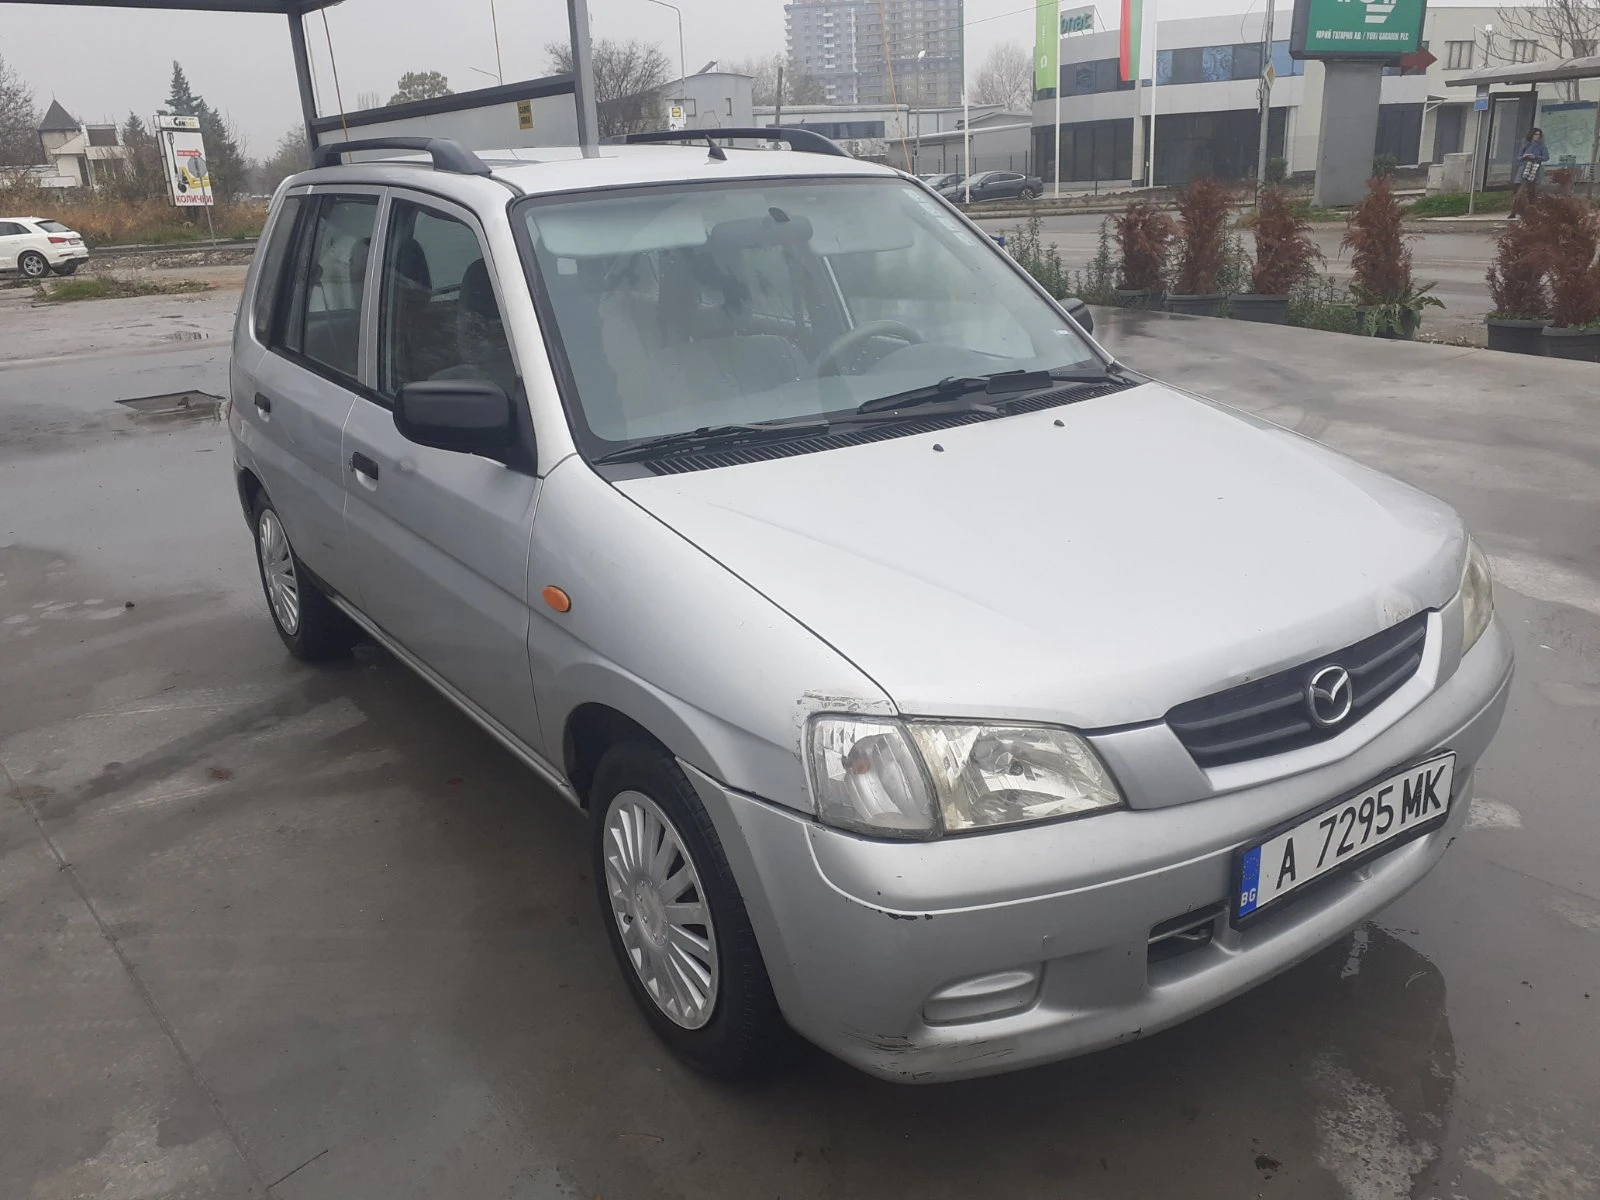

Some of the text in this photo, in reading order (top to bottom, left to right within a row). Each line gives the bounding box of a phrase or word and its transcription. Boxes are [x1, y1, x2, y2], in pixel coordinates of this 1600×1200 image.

[1276, 765, 1446, 890] A 7295 MK
[1241, 888, 1257, 907] BG
